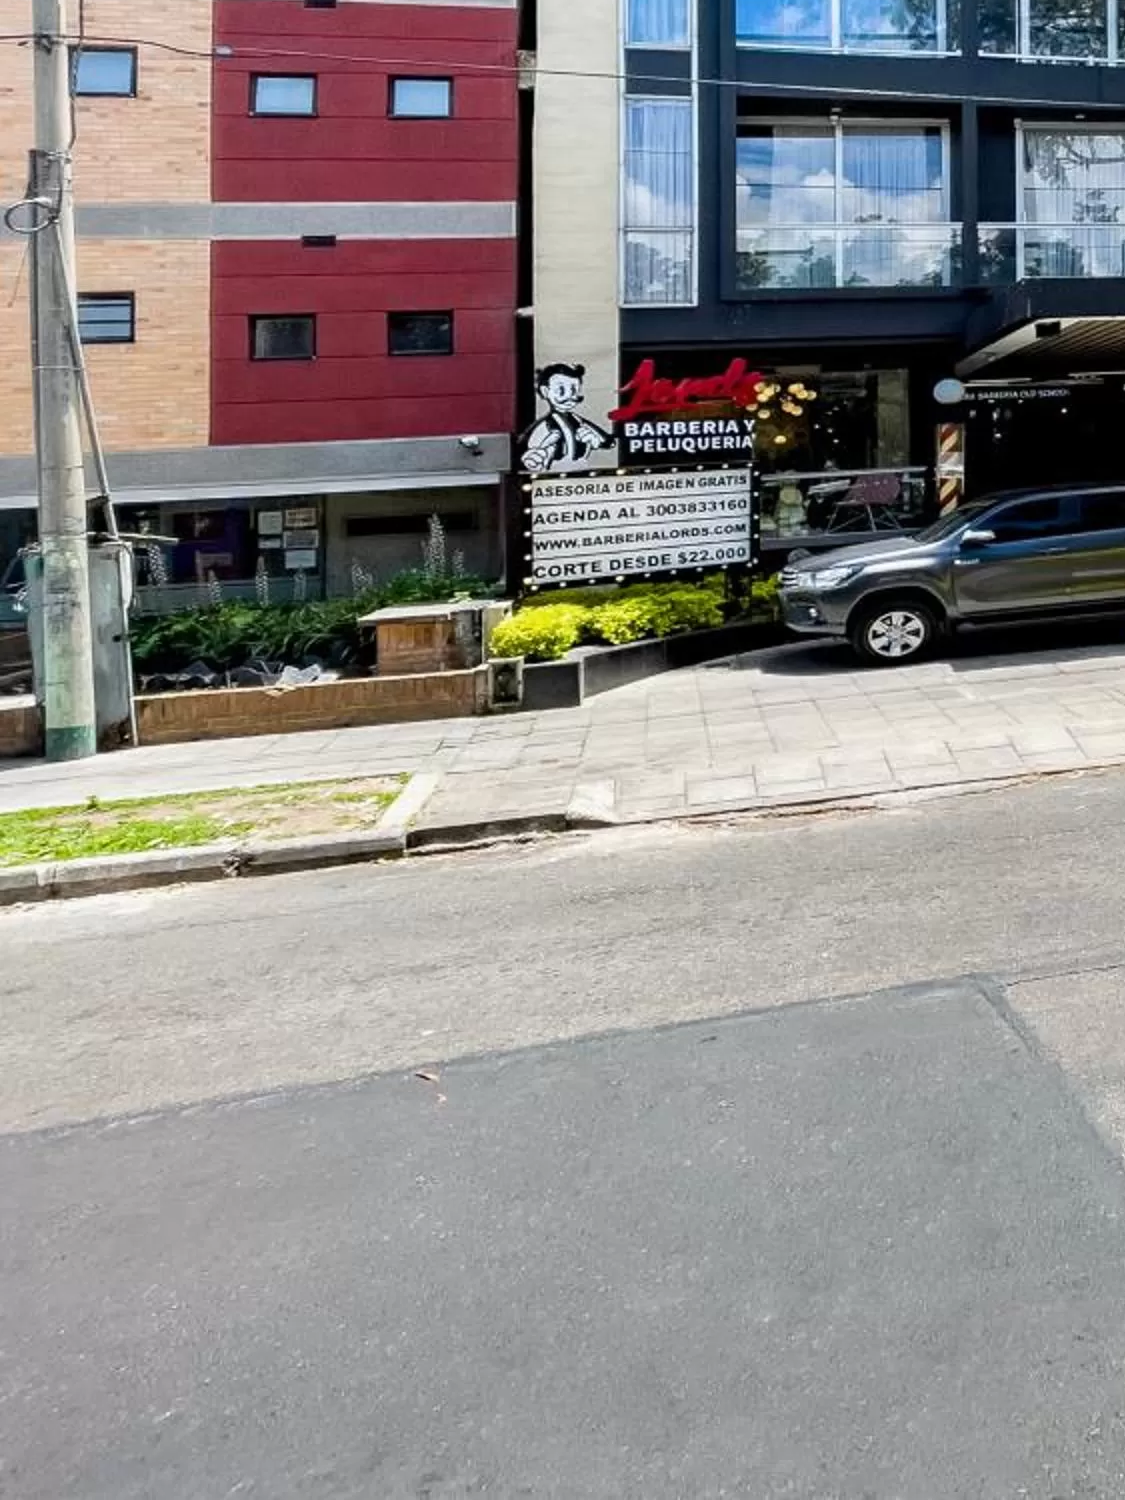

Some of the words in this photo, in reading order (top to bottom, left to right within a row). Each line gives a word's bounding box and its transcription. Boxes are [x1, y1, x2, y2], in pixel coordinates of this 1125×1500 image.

[624, 420, 739, 437] BARBERIA
[743, 419, 755, 433] Y
[629, 435, 753, 453] PELUQUERIA
[533, 485, 610, 499] ASESORIA
[615, 481, 634, 493] DE
[639, 477, 695, 492] IMAGEN
[697, 475, 747, 488] GRATIS
[533, 509, 610, 525] AGENDA
[617, 507, 640, 520] AL
[533, 562, 602, 579] CORTE
[609, 553, 672, 572] DESDE
[677, 547, 747, 565] $22.000
